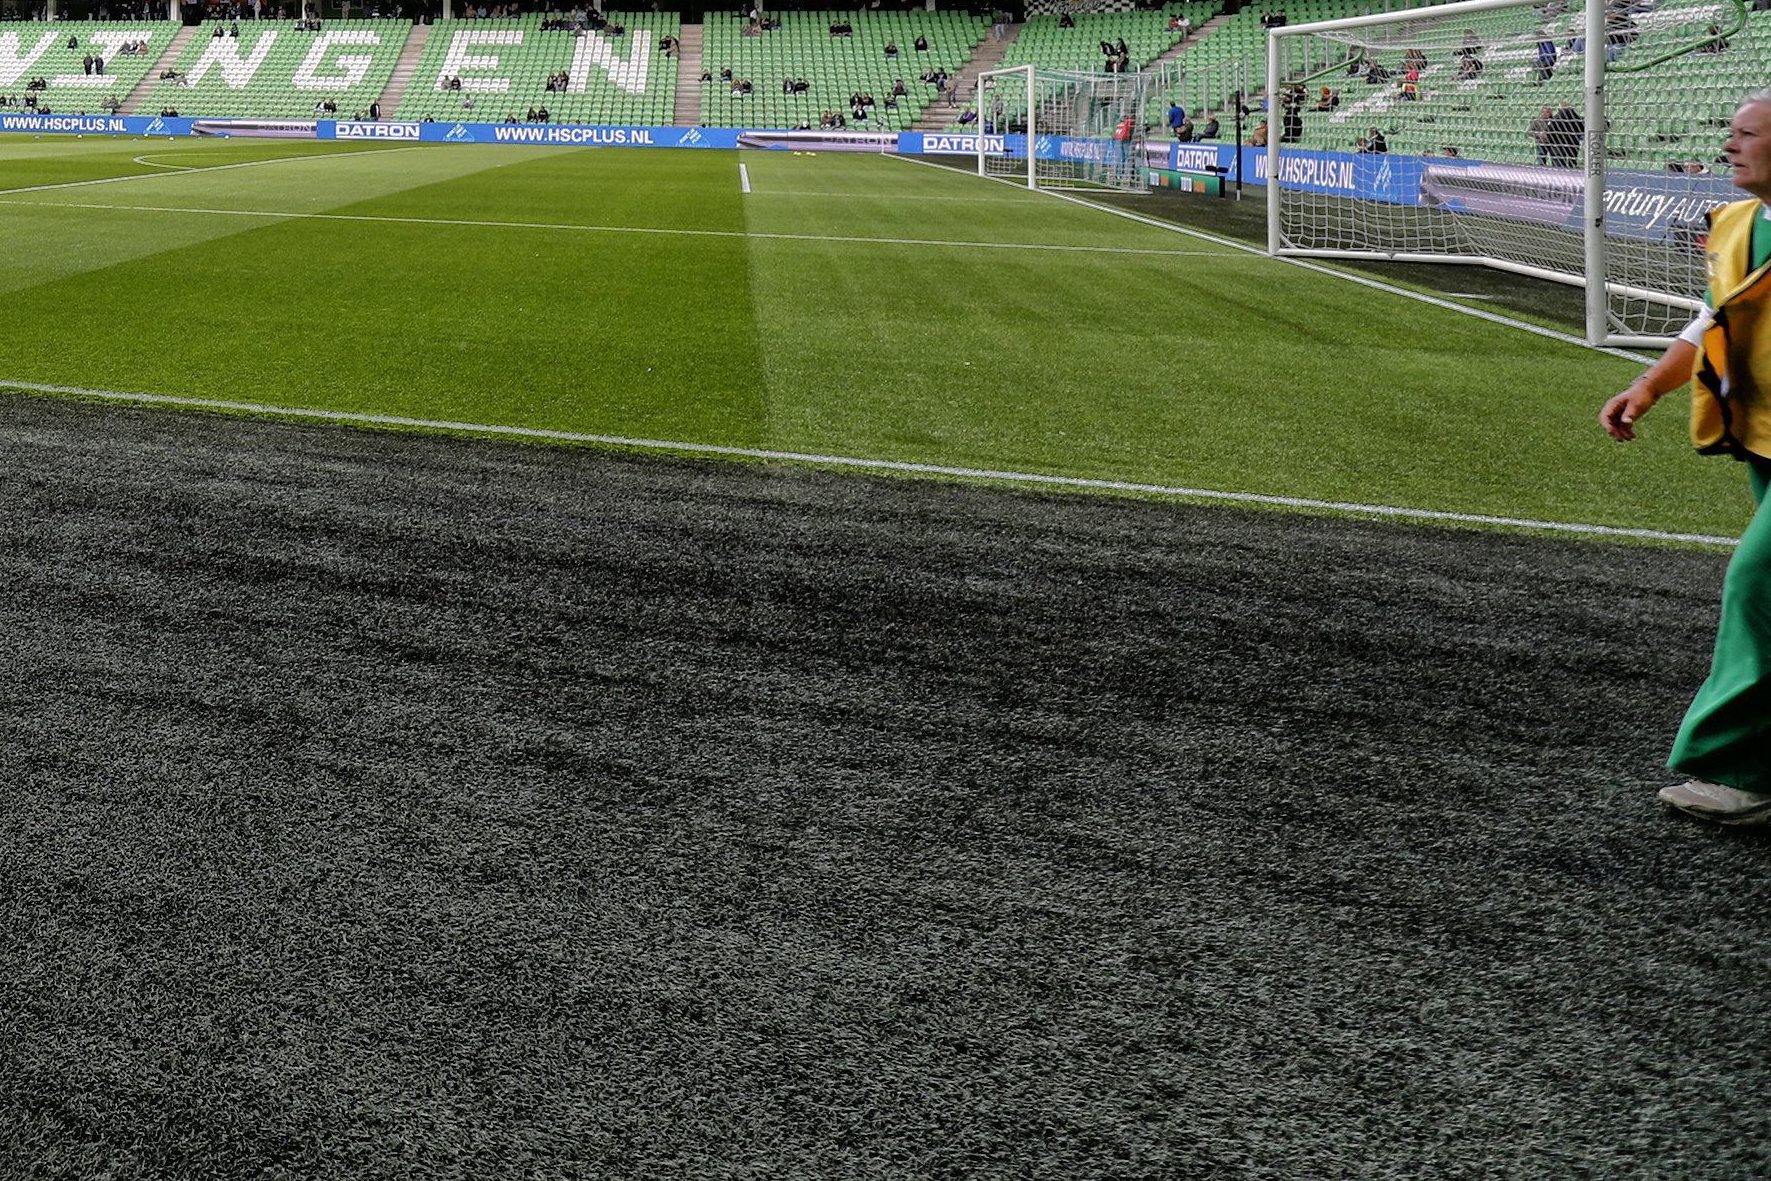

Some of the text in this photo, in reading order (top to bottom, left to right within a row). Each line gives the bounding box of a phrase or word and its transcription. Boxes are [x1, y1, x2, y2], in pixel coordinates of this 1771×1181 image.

[3, 117, 127, 131] WWW.HSCPLUS.NL
[336, 124, 420, 136] DATRON
[495, 127, 654, 144] WWW.HSCPLUS.NL
[923, 138, 1004, 152] DATRON
[1177, 150, 1218, 169] DATRON
[1255, 154, 1355, 189] W.HSCPLUS.NL
